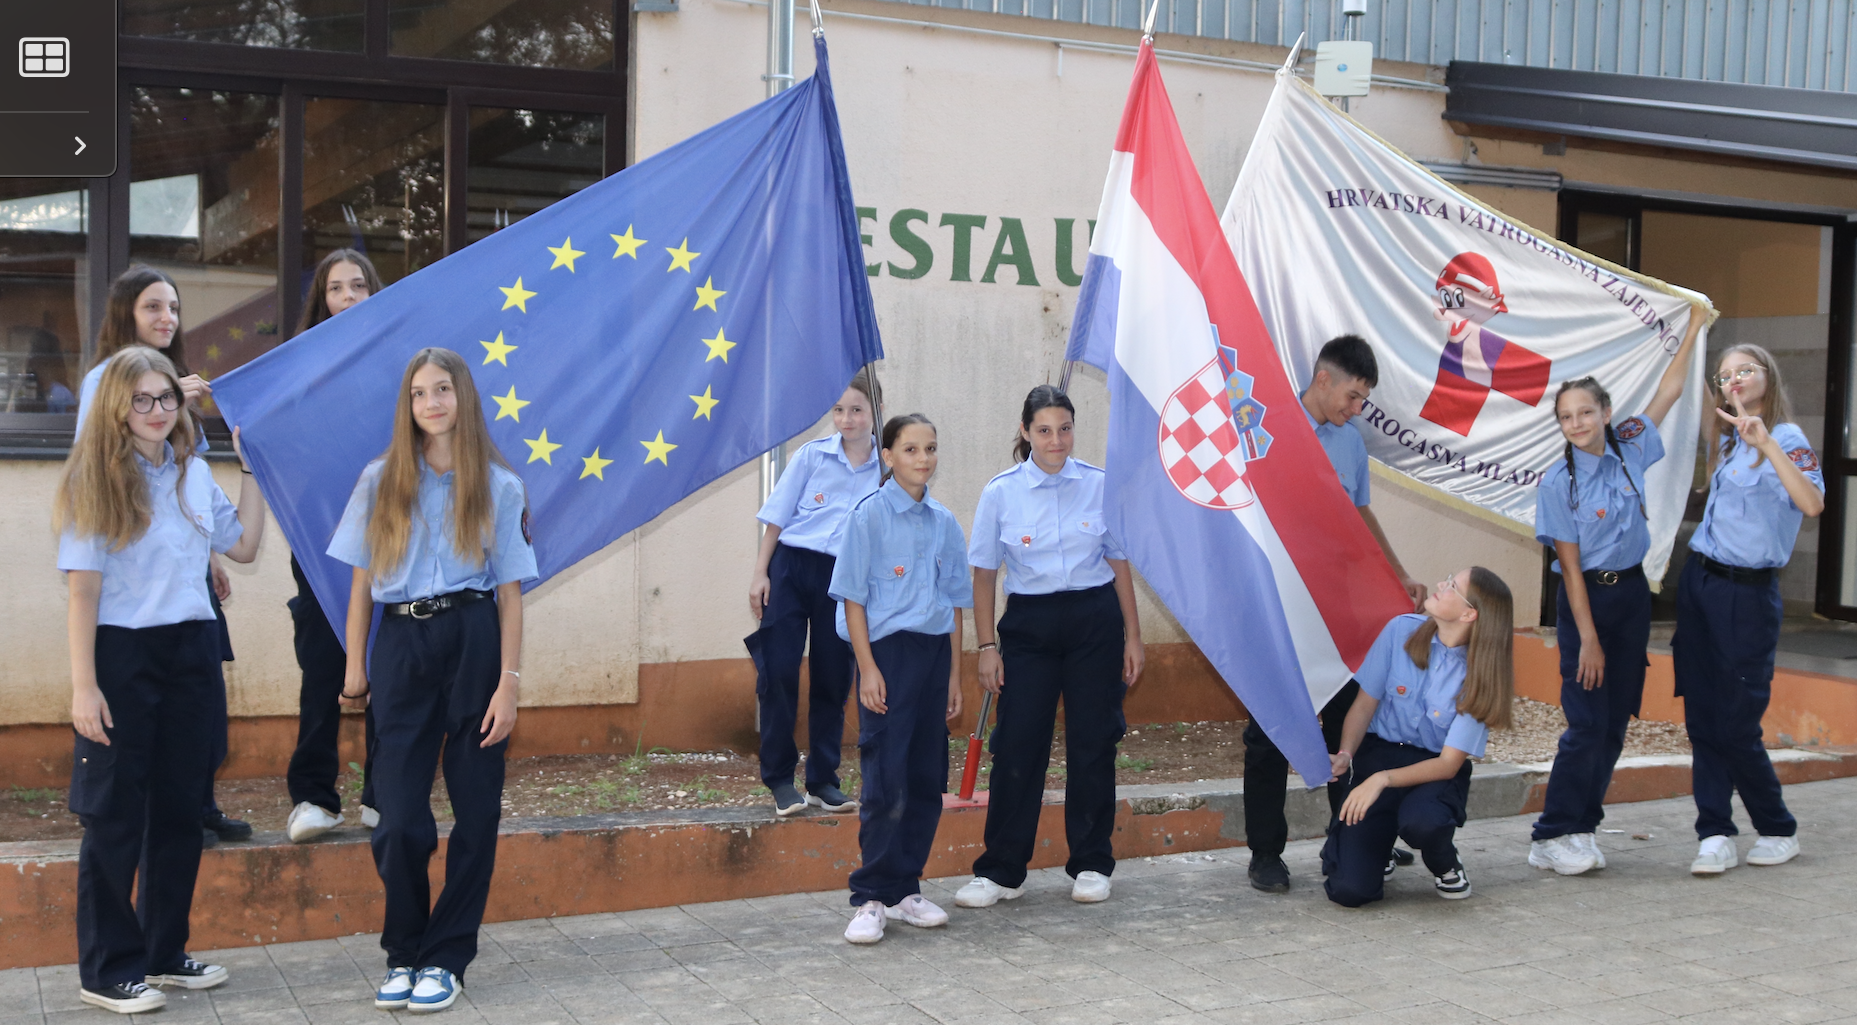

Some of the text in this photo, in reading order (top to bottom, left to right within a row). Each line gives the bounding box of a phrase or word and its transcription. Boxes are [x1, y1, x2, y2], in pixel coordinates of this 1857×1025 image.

[1325, 188, 1681, 357] HRVATSKA VATROGASNA ZAJEDNIC
